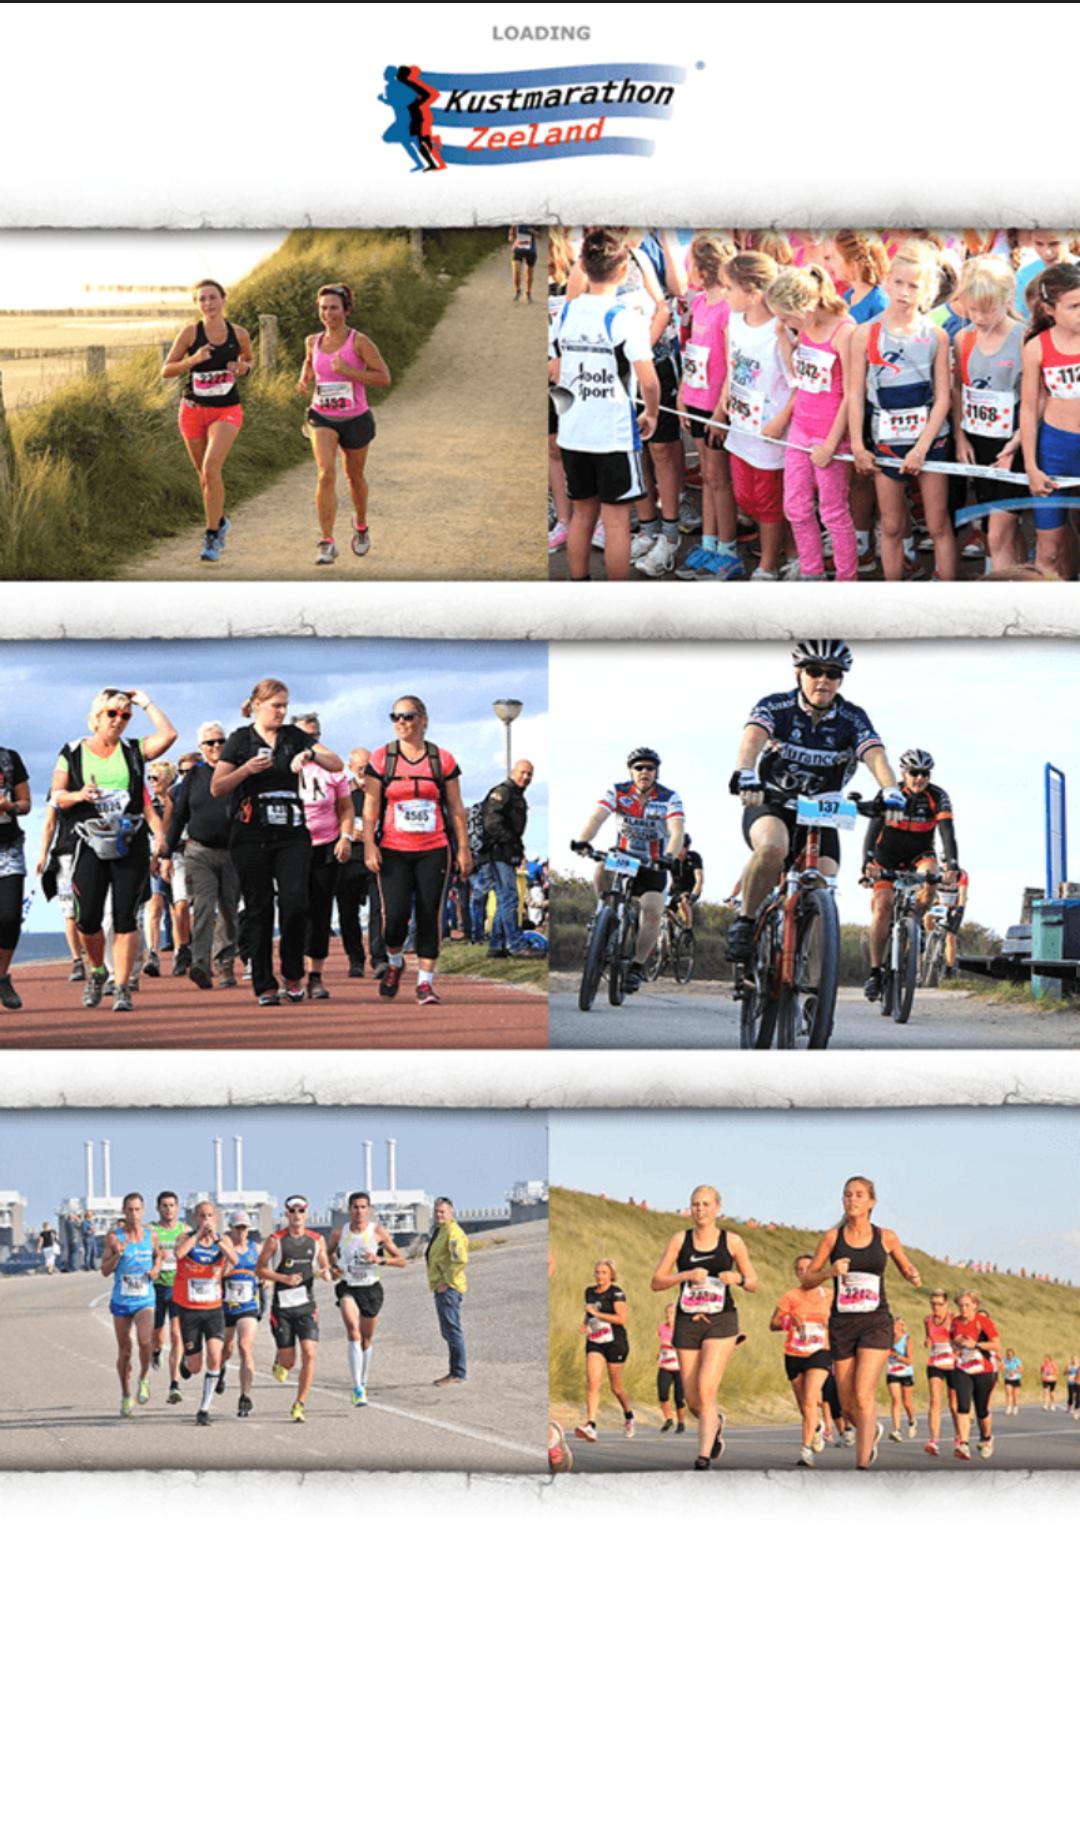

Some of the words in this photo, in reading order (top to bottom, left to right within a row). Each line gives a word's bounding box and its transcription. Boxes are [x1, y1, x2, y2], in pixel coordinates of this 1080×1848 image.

[492, 25, 591, 41] LOADING
[444, 78, 675, 115] Kustmarathon
[466, 116, 606, 151] Zeeland
[818, 800, 840, 814] 137
